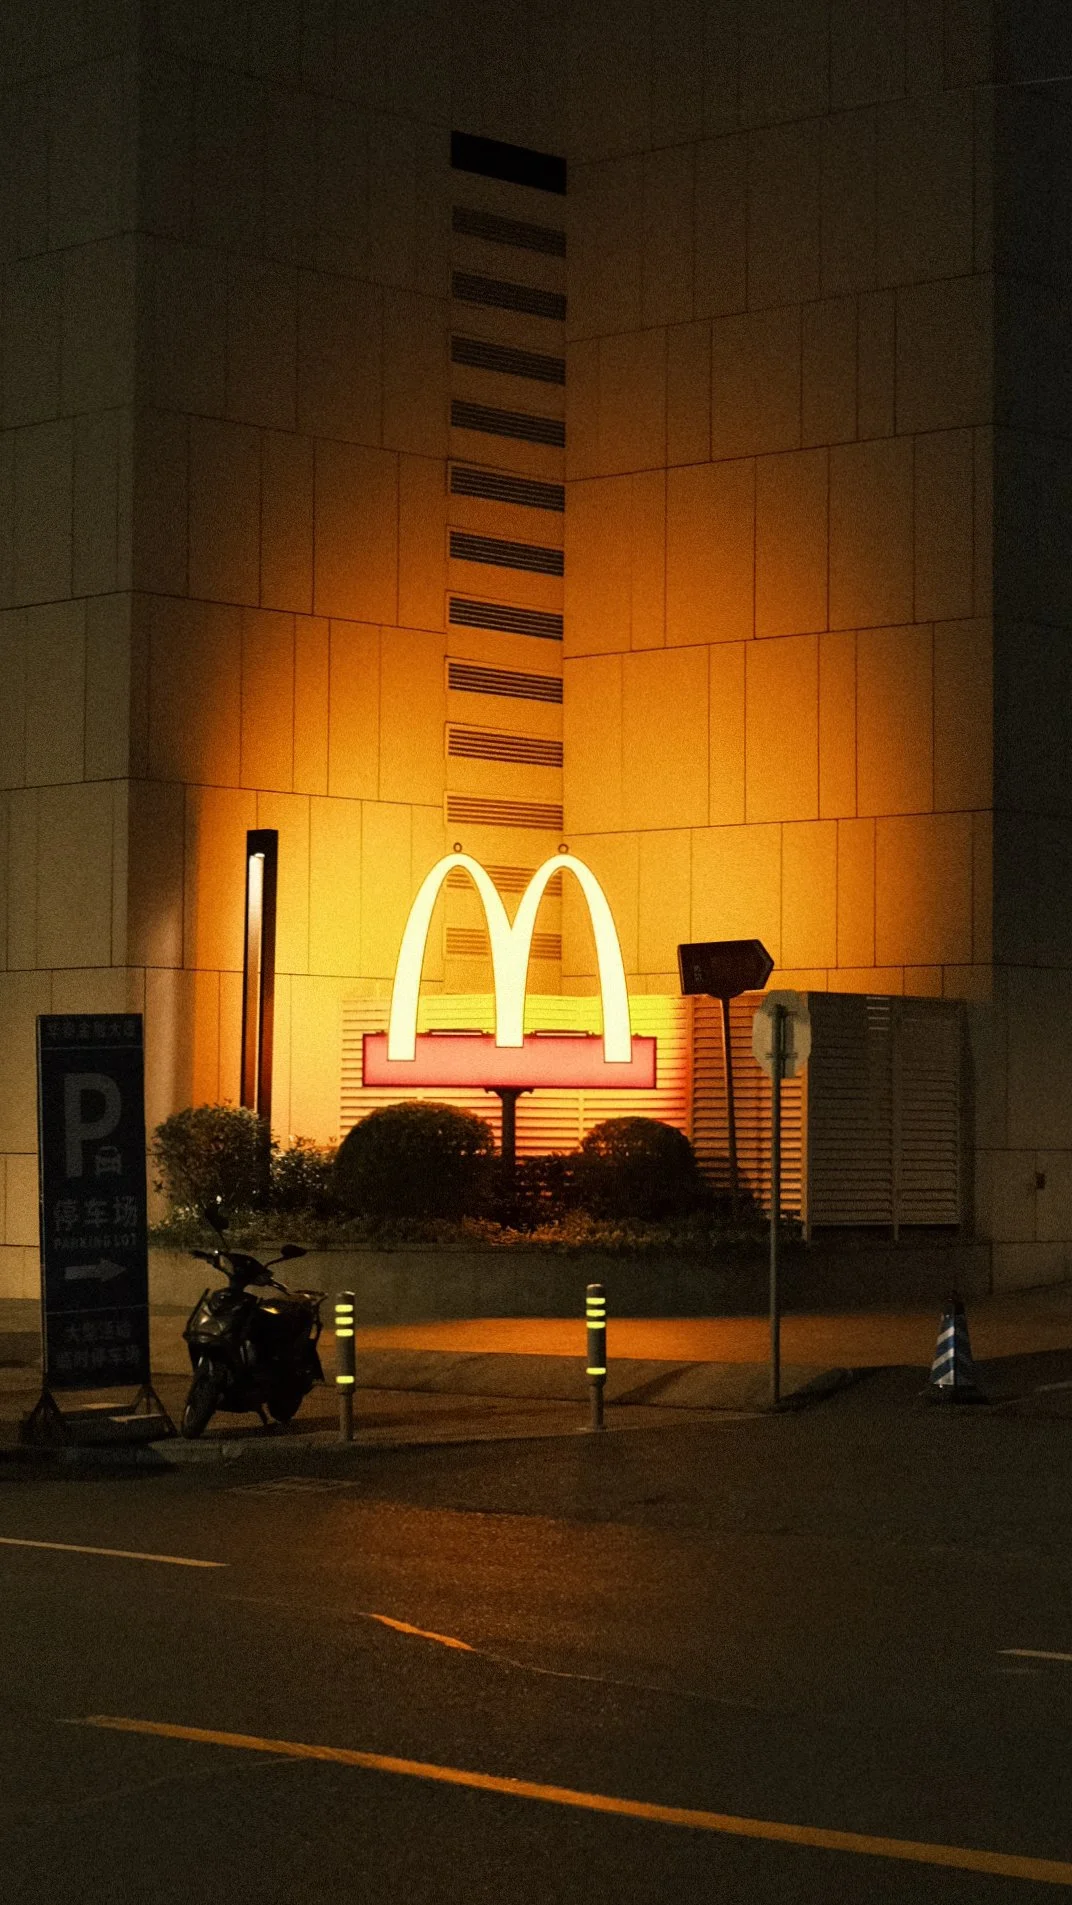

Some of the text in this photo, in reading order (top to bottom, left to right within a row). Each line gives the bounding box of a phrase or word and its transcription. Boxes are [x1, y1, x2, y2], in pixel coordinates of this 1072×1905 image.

[64, 1072, 122, 1178] P
[54, 1196, 138, 1232] 停车场
[53, 1232, 136, 1249] PARKING LOT
